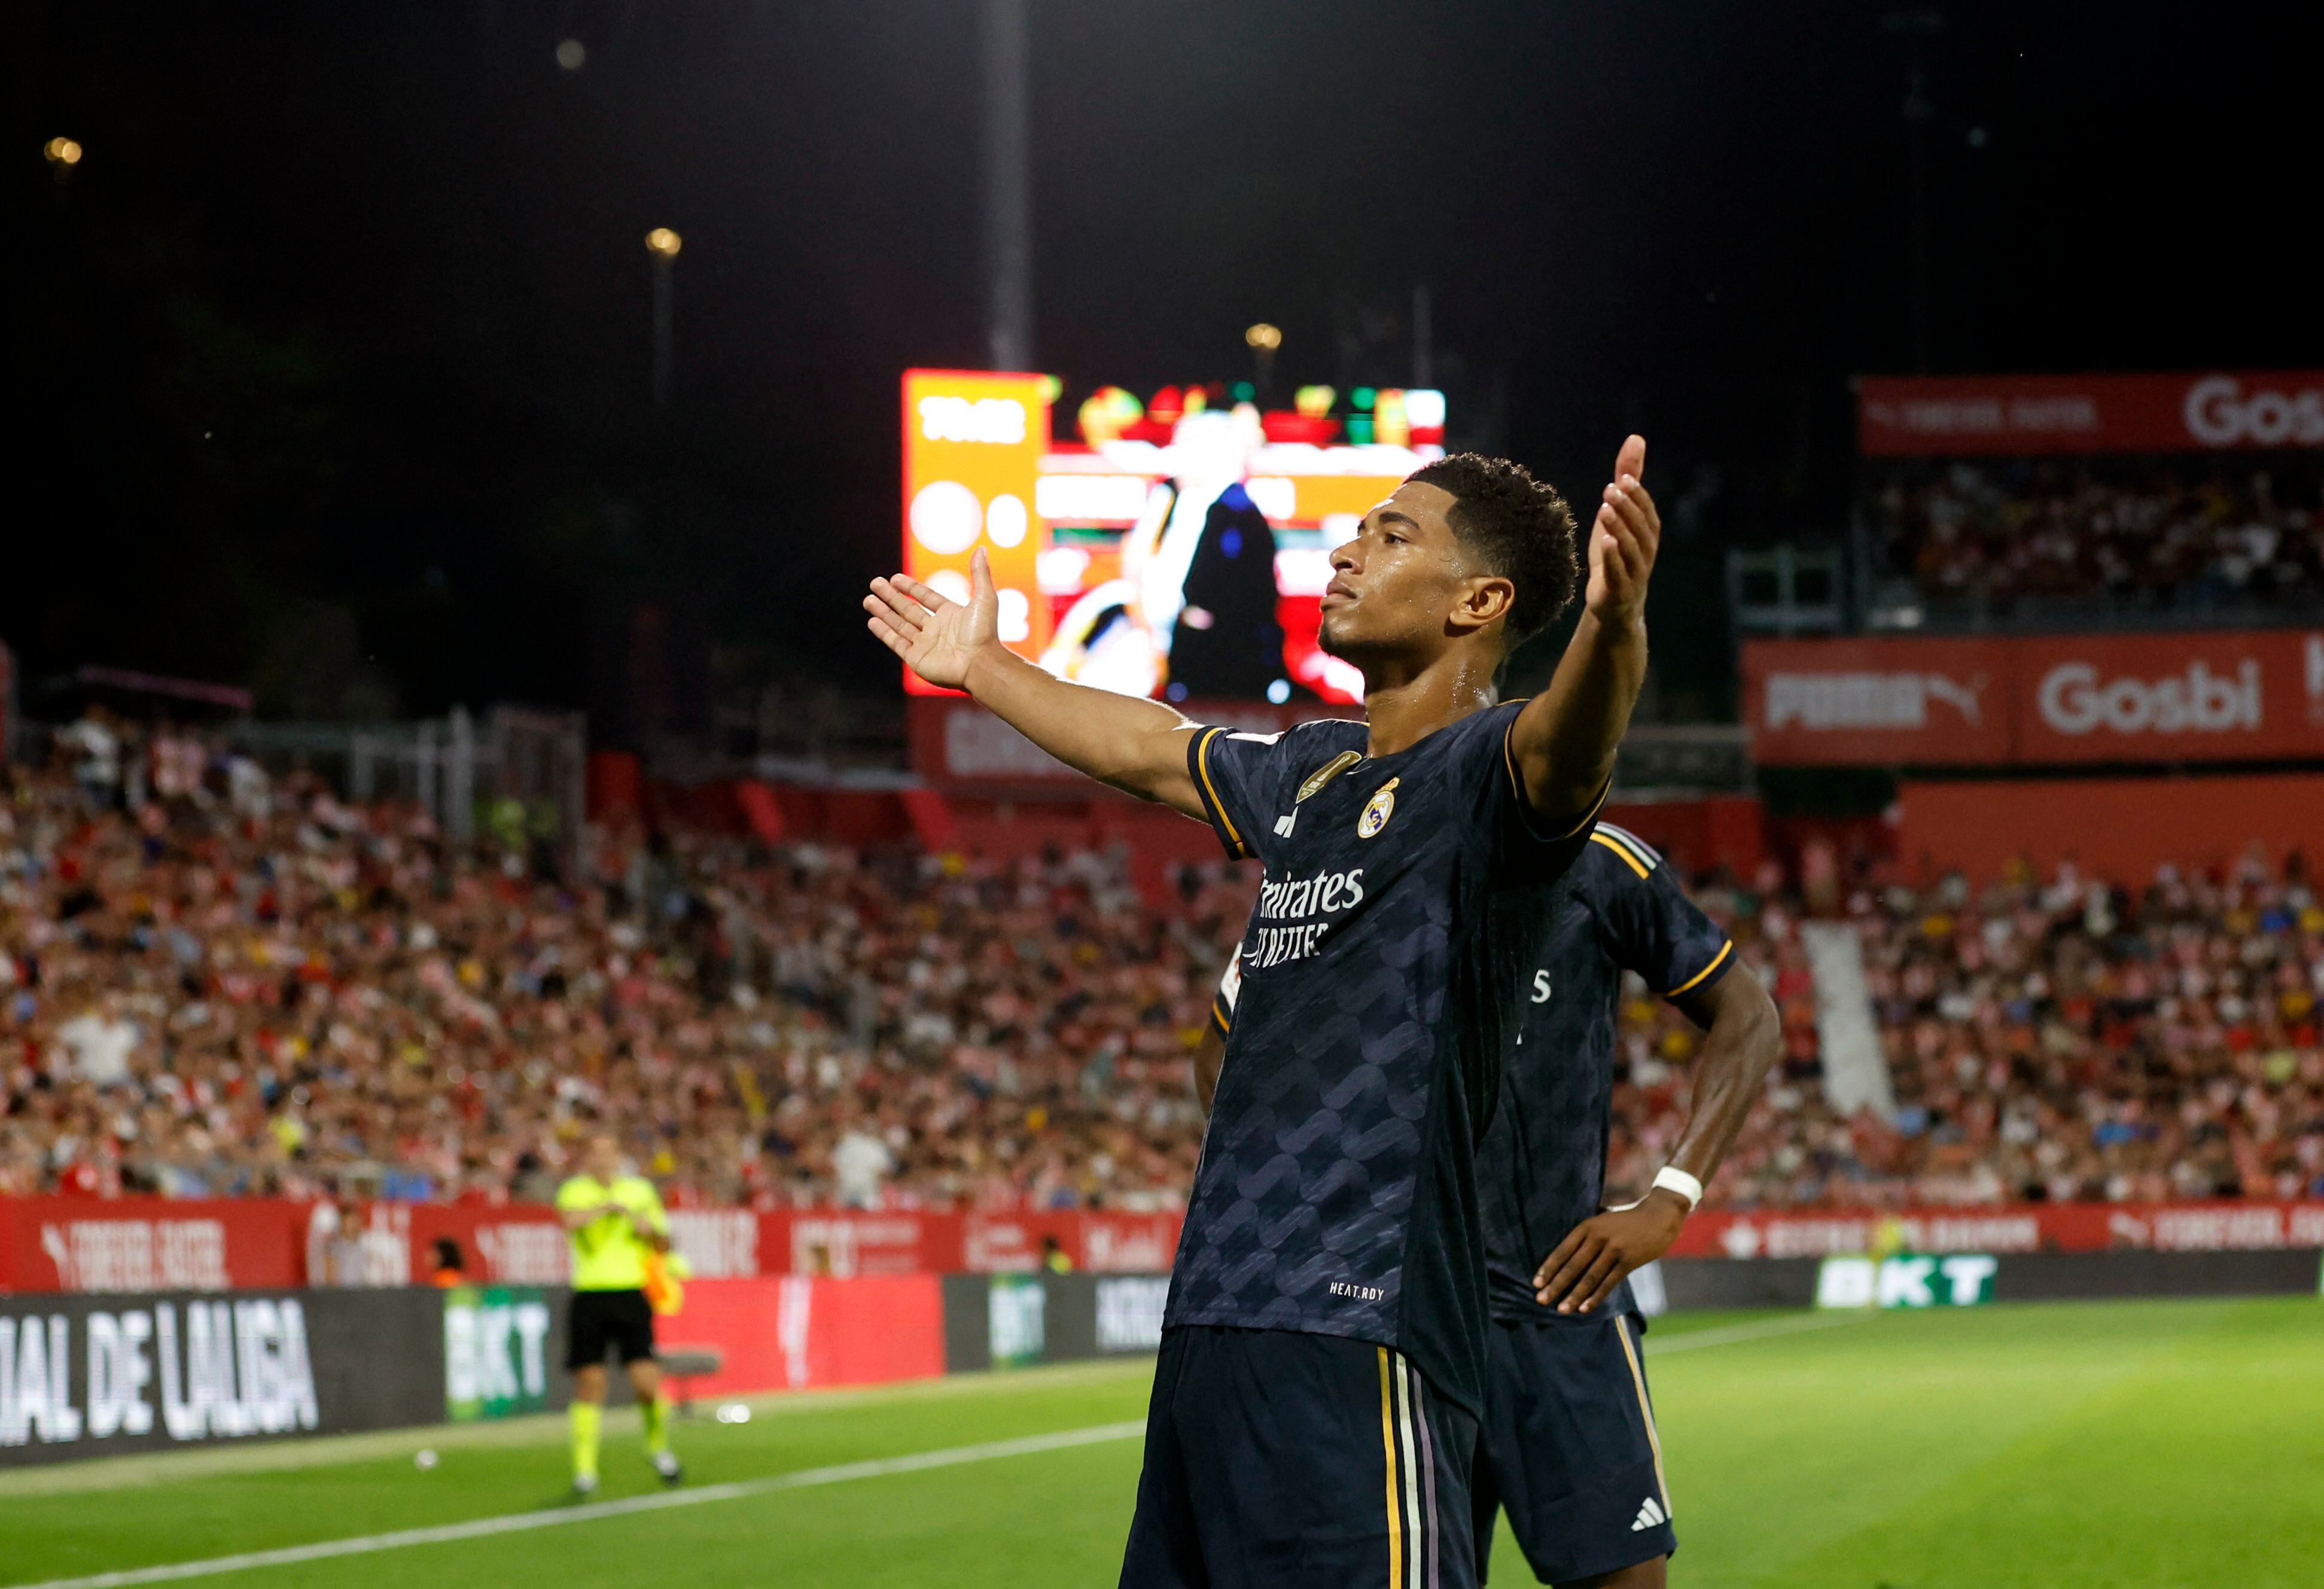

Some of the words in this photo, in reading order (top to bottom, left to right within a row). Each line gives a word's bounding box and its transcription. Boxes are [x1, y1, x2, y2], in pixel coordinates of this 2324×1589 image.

[2037, 659, 2260, 735] Gosbi
[1260, 867, 1364, 919] mirates
[1330, 1281, 1384, 1301] HEAT.RDY
[1817, 1255, 1998, 1309] BKT
[87, 1310, 154, 1438] DE
